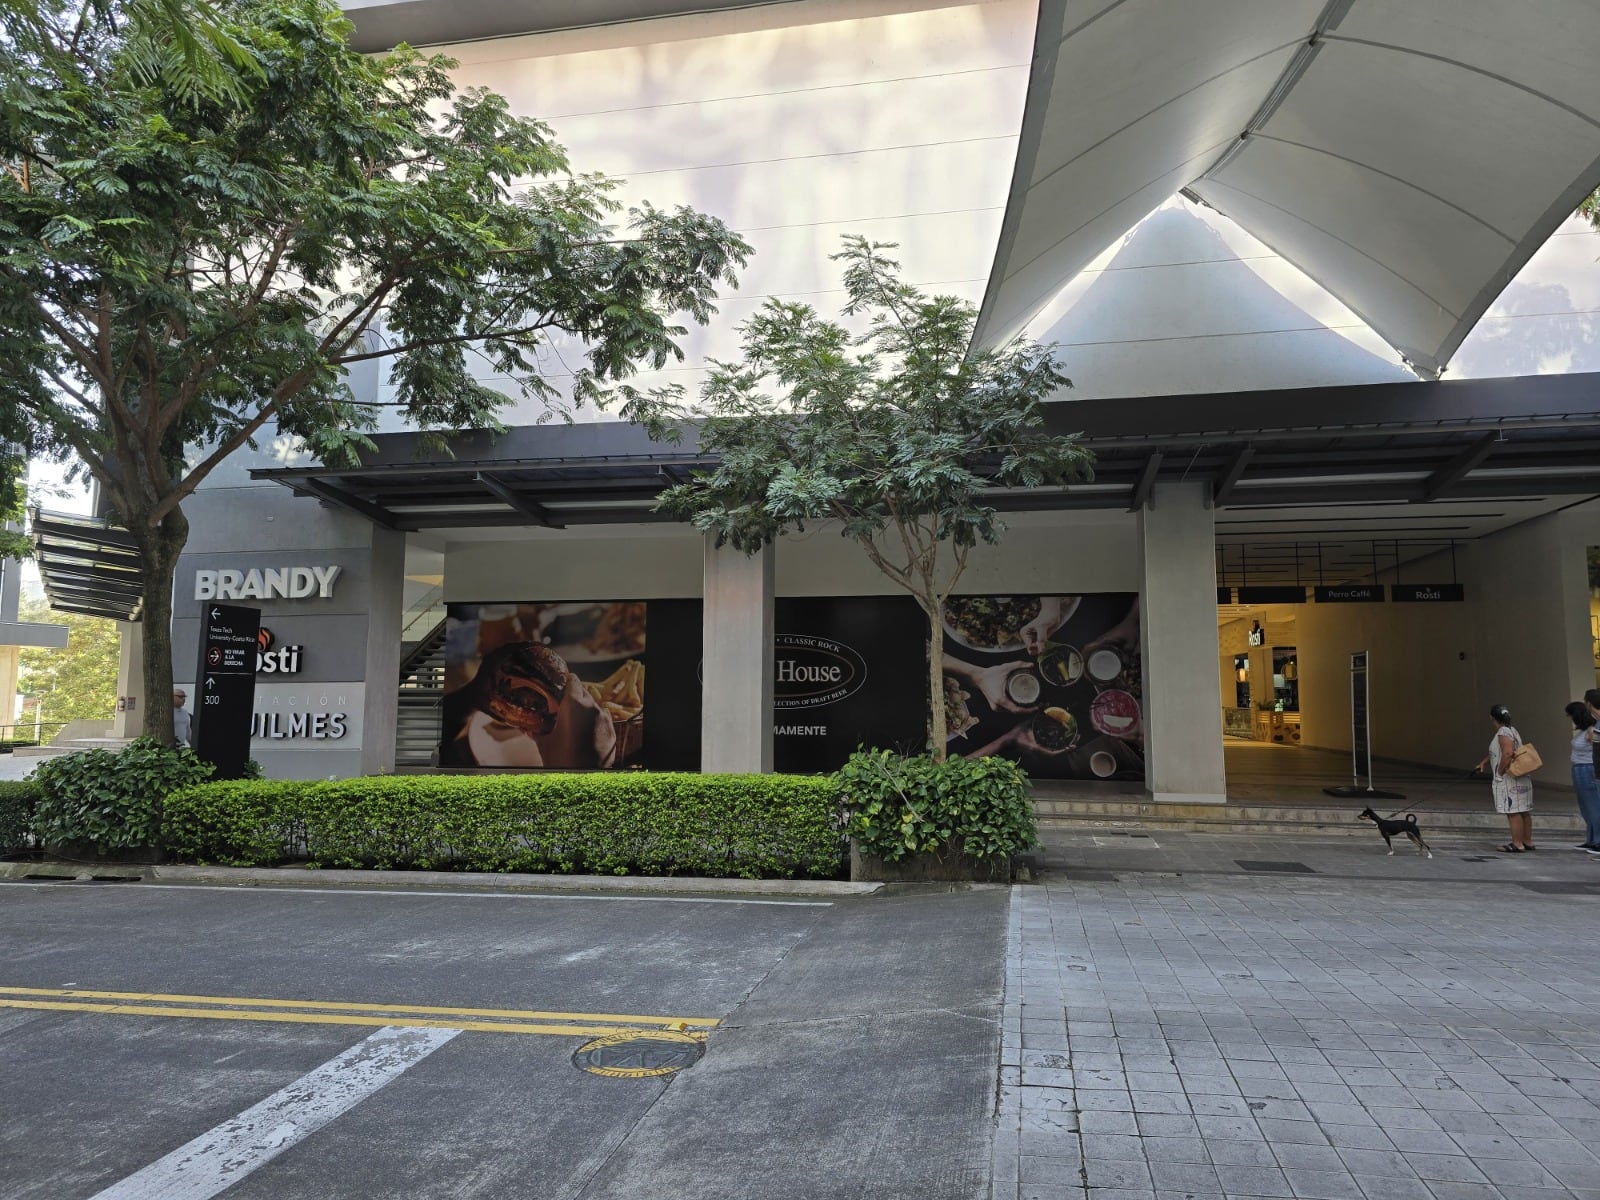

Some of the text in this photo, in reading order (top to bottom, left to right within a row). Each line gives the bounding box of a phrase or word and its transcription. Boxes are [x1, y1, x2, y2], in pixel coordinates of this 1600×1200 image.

[194, 565, 341, 600] BRANDY
[1328, 590, 1349, 598] Perro
[784, 636, 841, 653] CLASSIC ROCK
[776, 660, 841, 682] House
[204, 695, 220, 705] 300
[774, 699, 801, 707] LECTION
[810, 695, 831, 705] DRAFT
